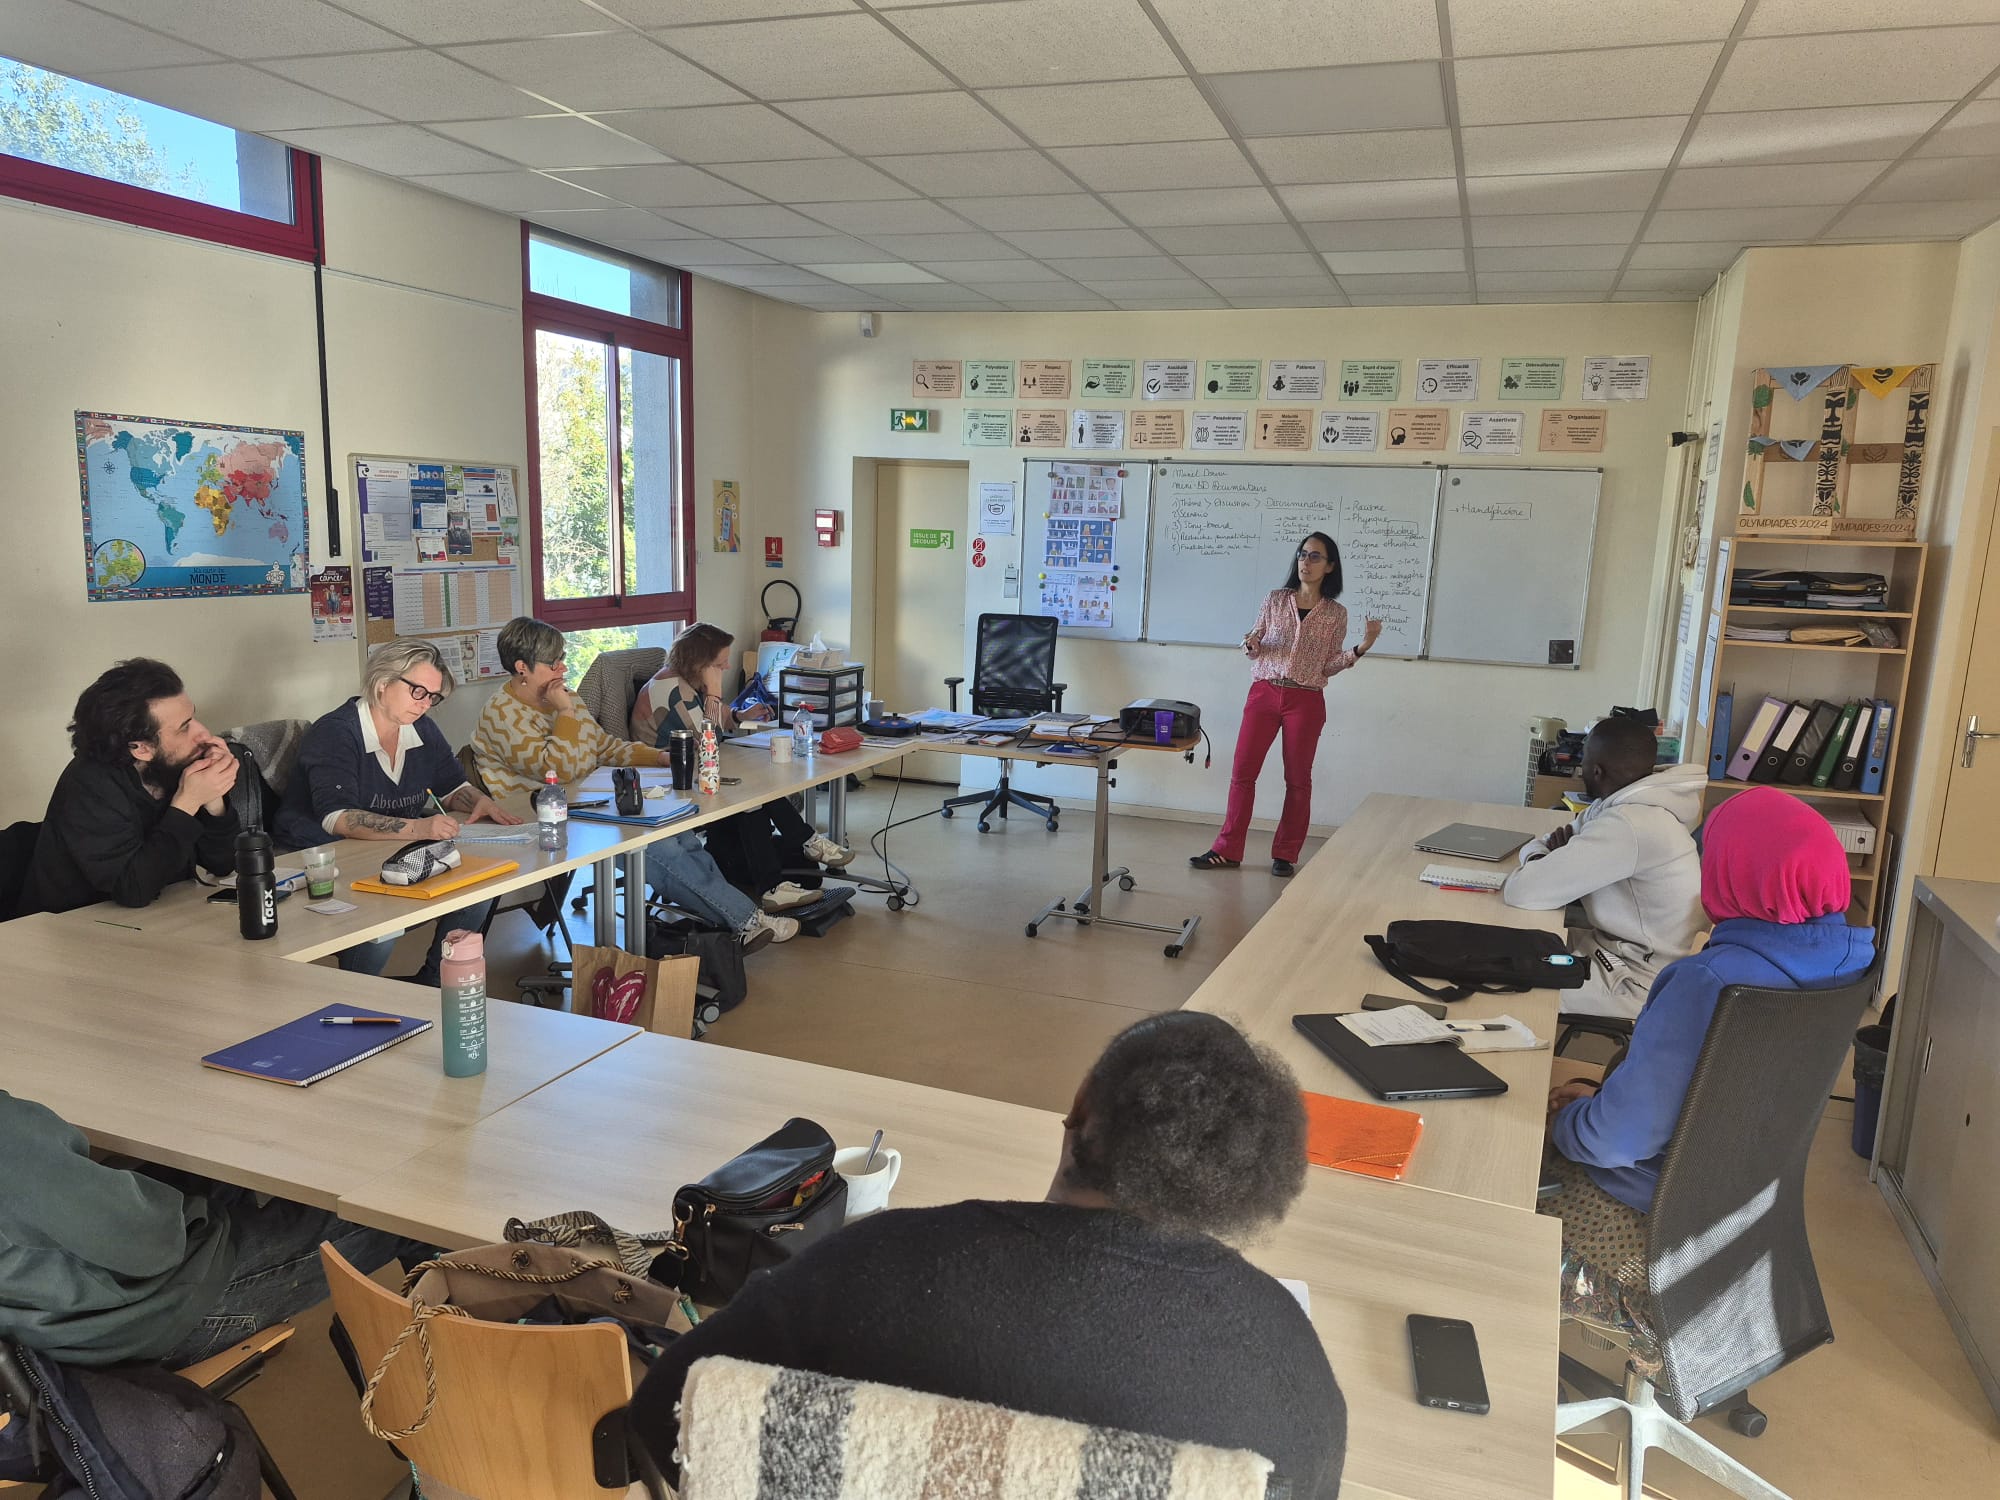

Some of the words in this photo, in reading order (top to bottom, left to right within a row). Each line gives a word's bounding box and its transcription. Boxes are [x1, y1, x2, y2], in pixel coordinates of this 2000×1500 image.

[1739, 518, 1798, 529] OLYMPIADES
[1799, 518, 1829, 528] 2024
[1882, 523, 1912, 534] 2024
[189, 573, 228, 585] MONDE
[262, 888, 275, 927] Tacx
